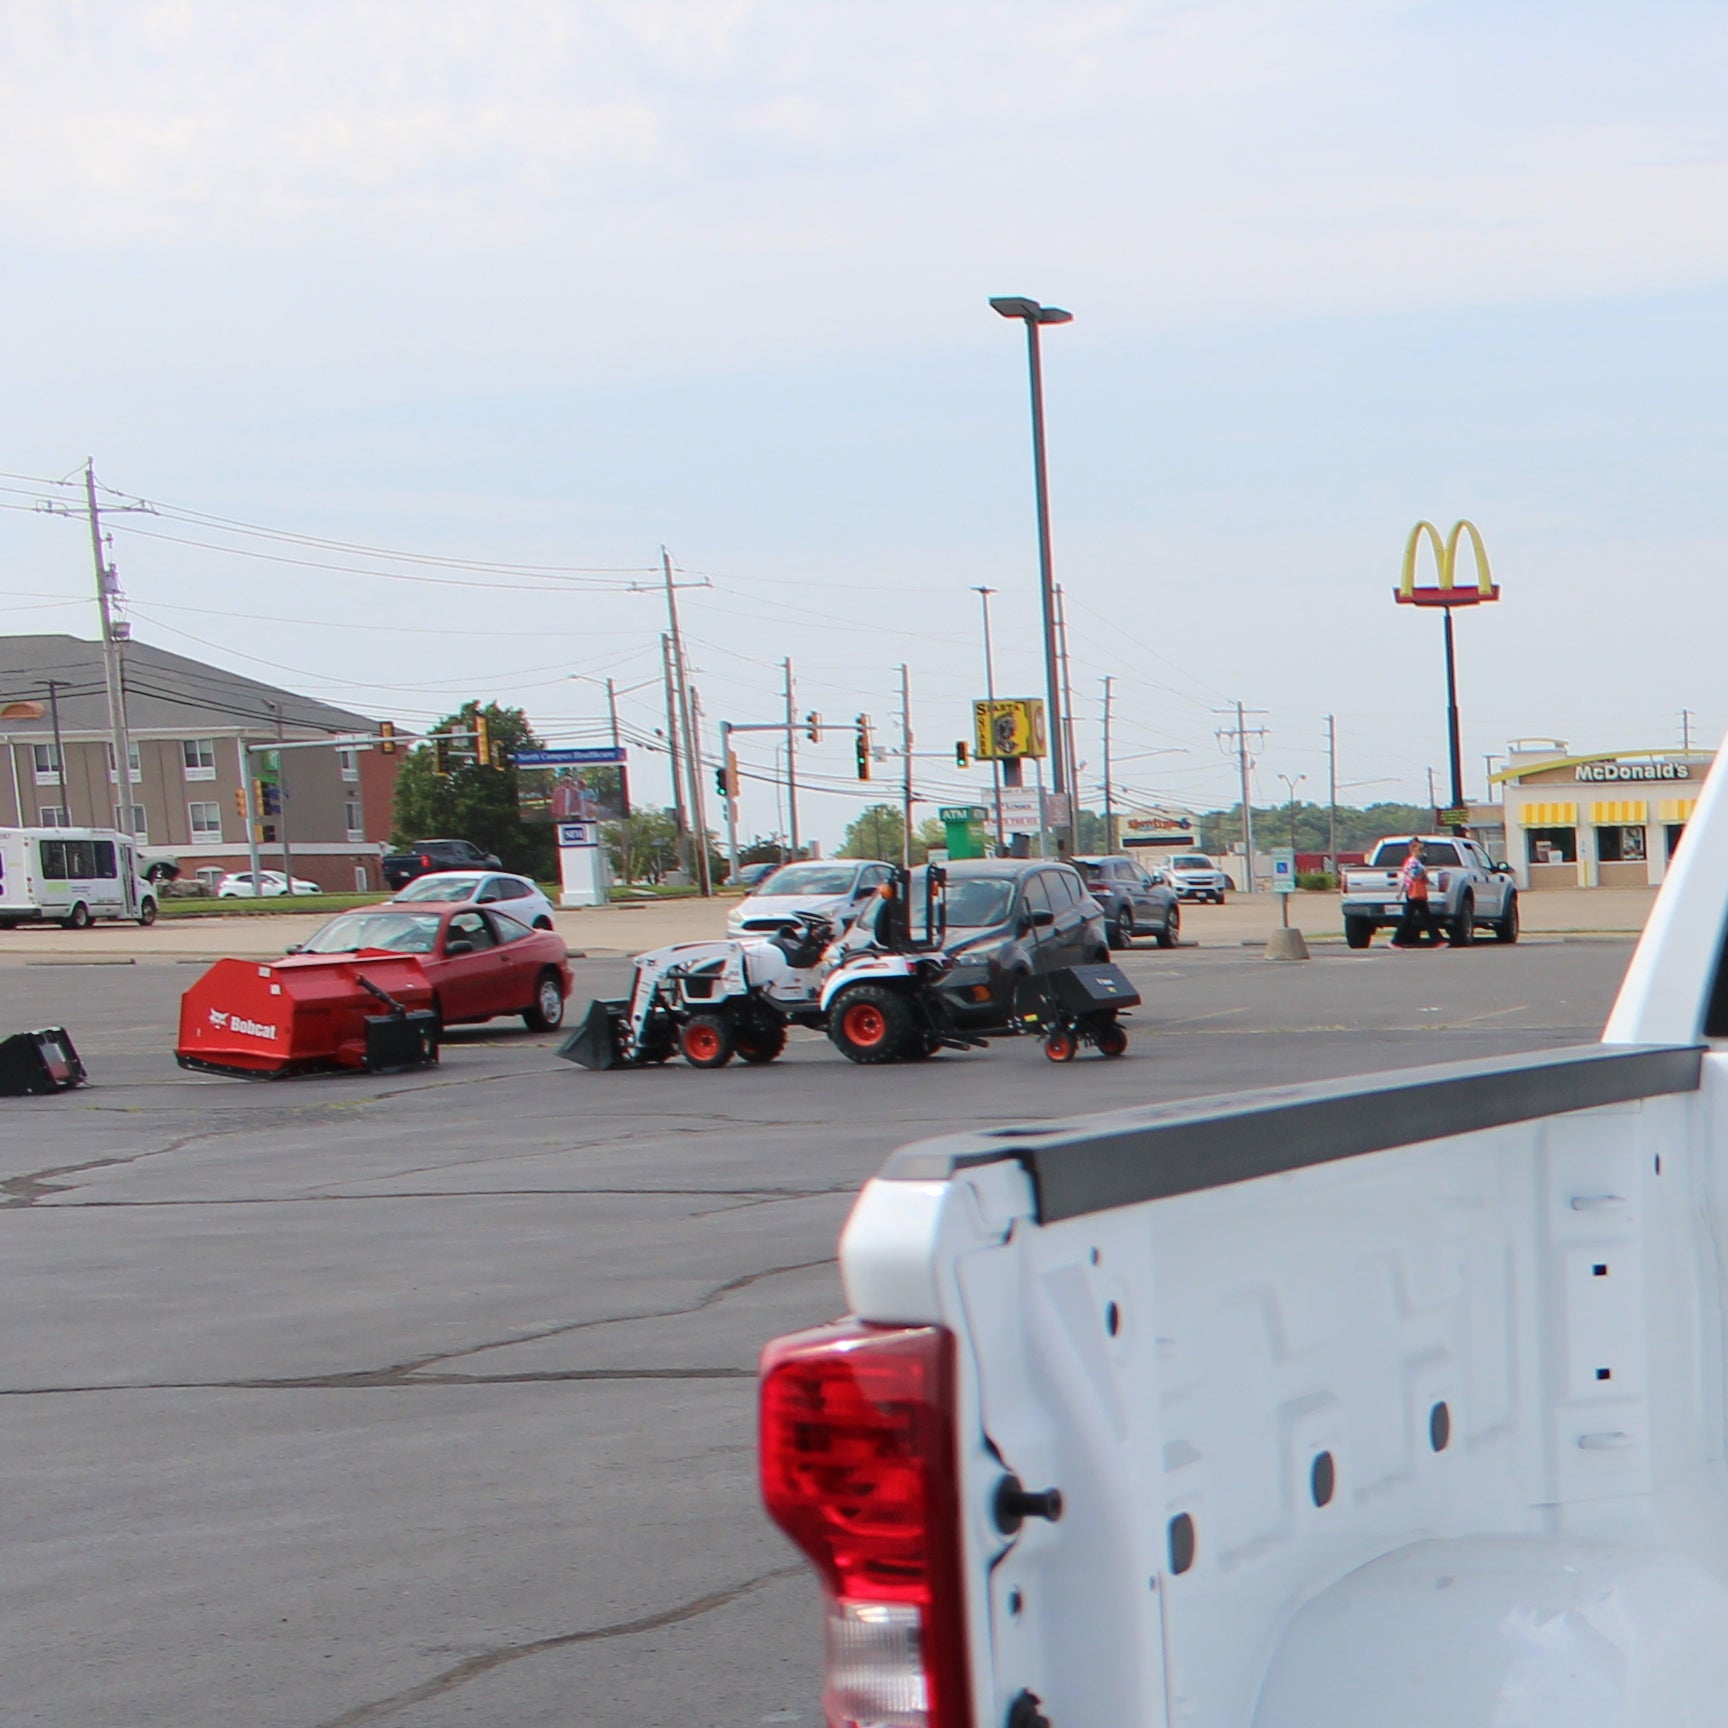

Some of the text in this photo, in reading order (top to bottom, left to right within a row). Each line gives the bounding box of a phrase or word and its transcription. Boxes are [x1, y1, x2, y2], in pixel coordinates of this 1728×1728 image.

[1575, 763, 1689, 781] McDonald's
[942, 808, 968, 820] ATM
[230, 1015, 277, 1040] Bobcat
